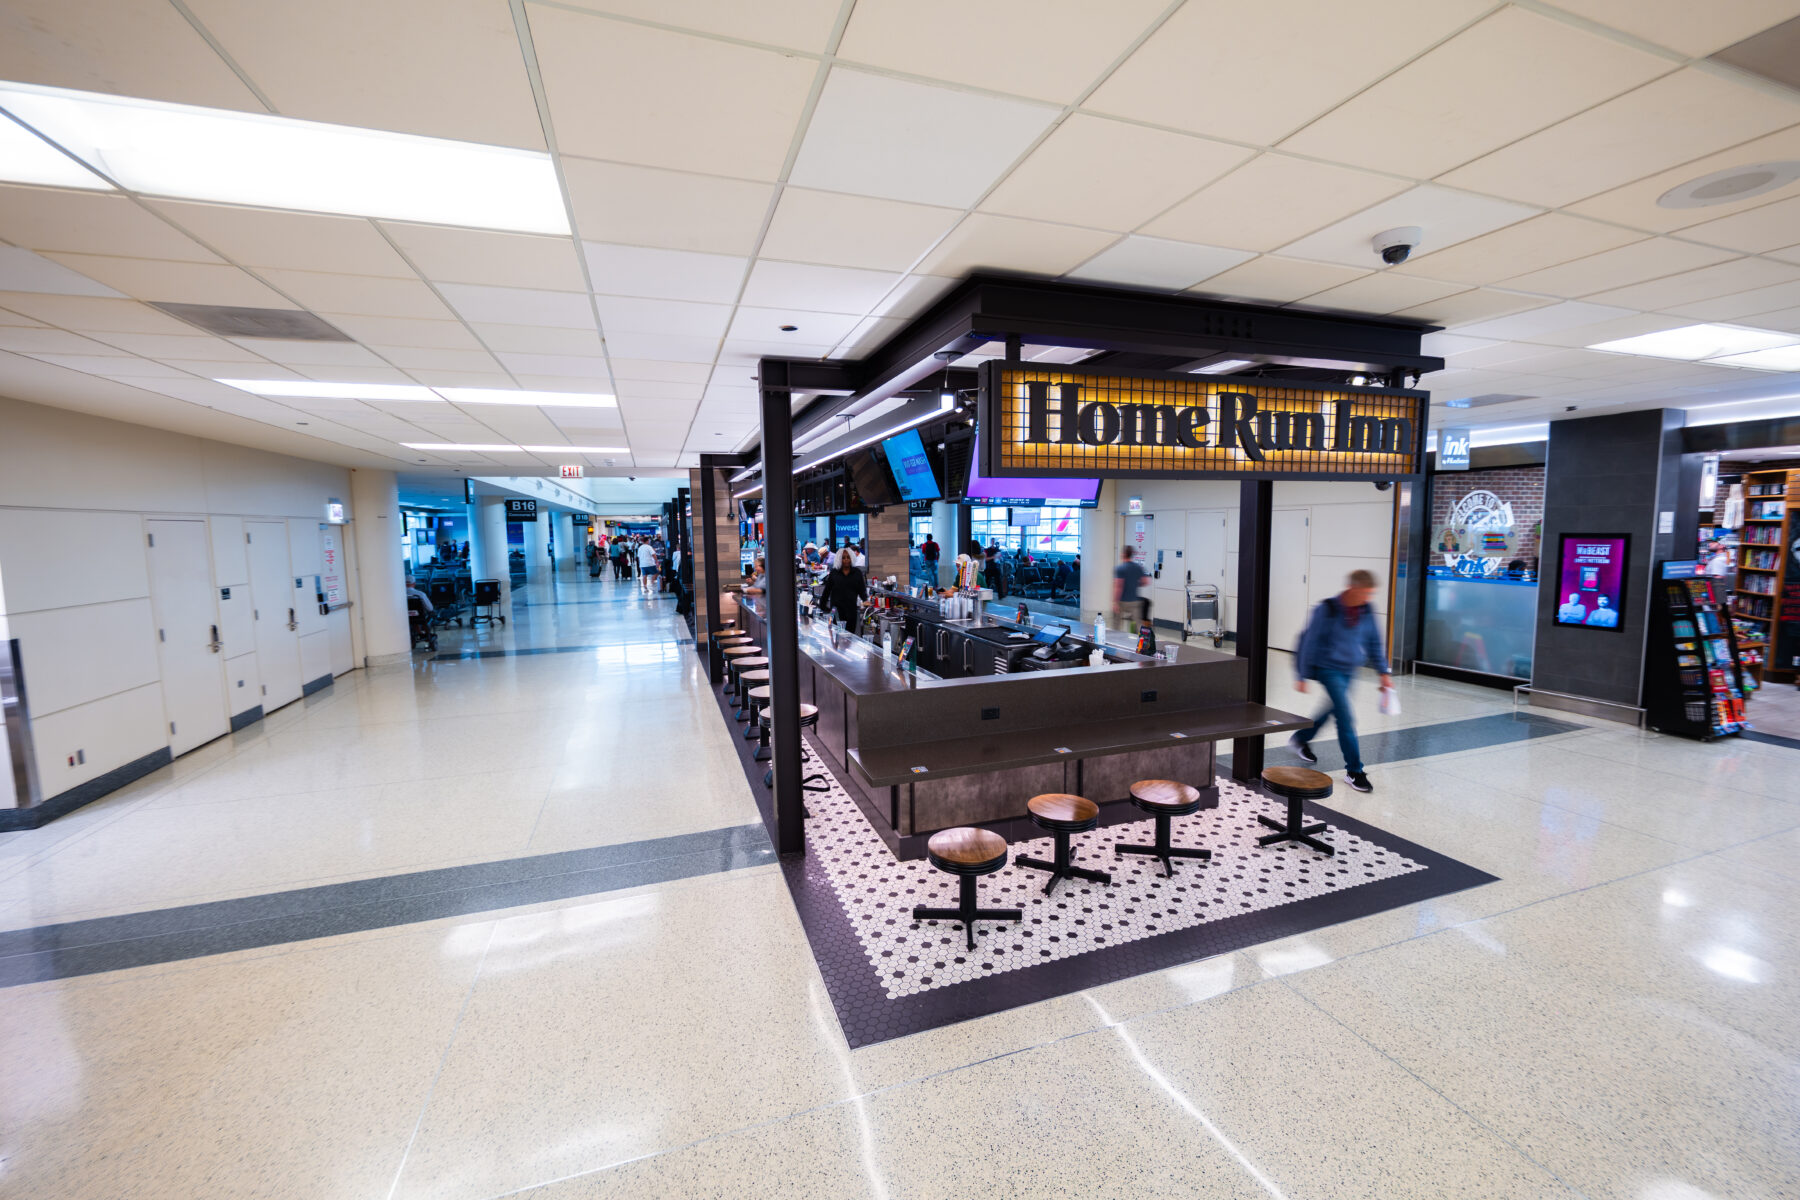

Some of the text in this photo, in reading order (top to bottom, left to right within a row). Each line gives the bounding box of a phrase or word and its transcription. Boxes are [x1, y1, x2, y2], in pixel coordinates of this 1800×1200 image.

[1024, 381, 1412, 461] Home Run Inn
[1442, 435, 1469, 456] ink
[562, 466, 580, 476] EXIT
[512, 501, 535, 511] B16
[911, 499, 927, 508] B17
[1456, 555, 1488, 573] ink
